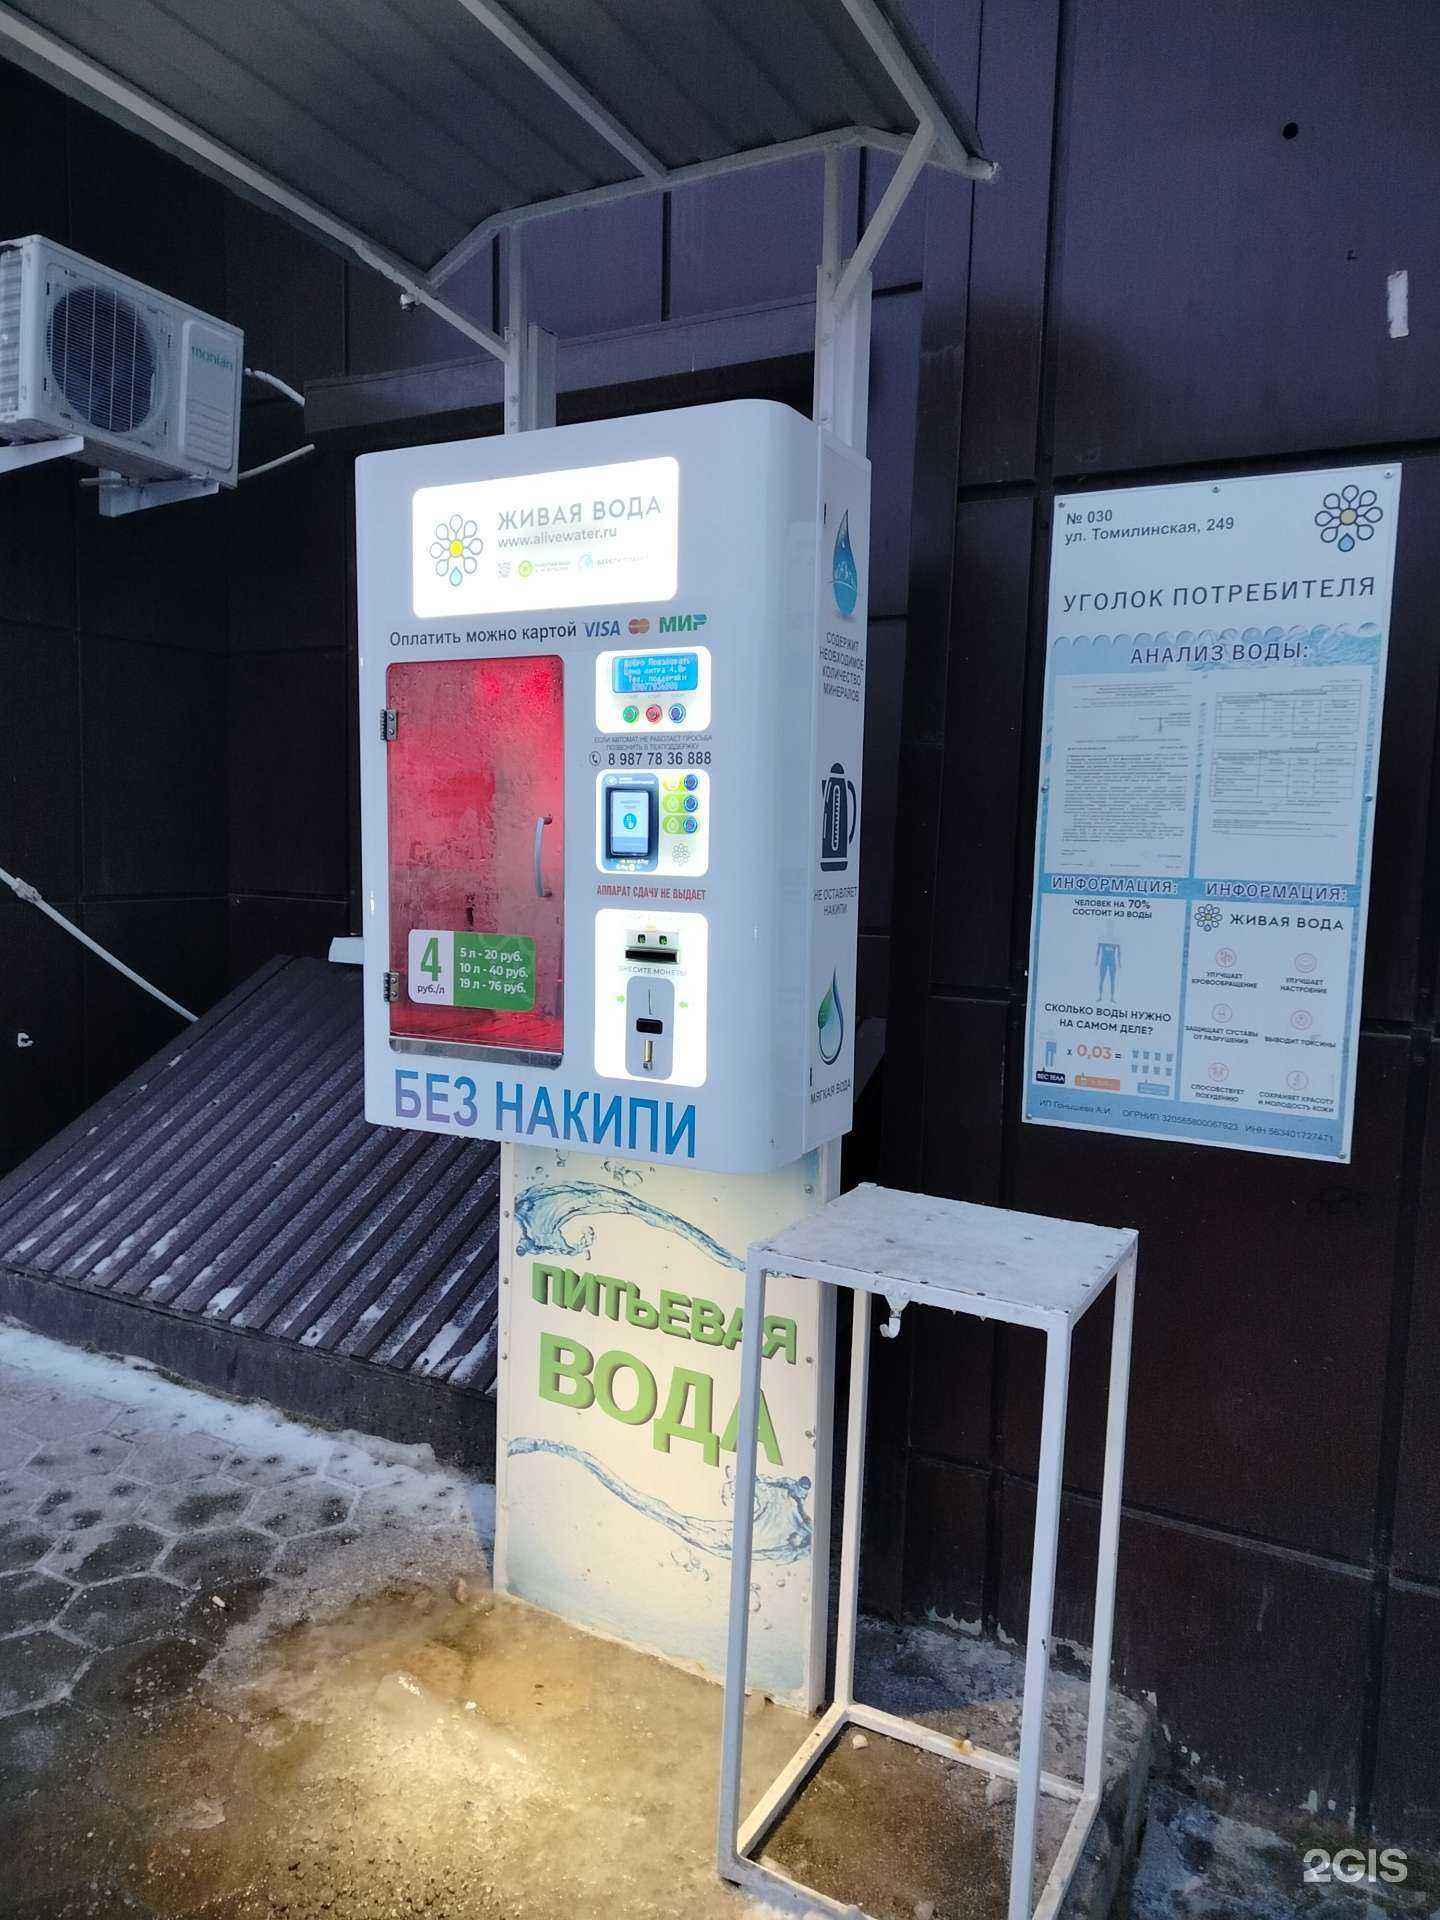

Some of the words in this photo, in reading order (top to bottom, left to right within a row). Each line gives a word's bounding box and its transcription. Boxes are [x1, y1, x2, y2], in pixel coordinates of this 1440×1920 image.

[498, 503, 582, 530] ЖИВАЯ
[593, 496, 661, 520] ВОДА
[1066, 513, 1082, 525] №
[1088, 510, 1113, 523] 030
[498, 527, 617, 548] www.alivewater.ru
[1065, 532, 1087, 546] ул.
[1093, 522, 1201, 540] Томилинская,
[1206, 517, 1234, 531] 249
[1063, 589, 1164, 612] УГОЛОК
[1173, 577, 1375, 606] ПОТРЕБИТЕЛЯ
[390, 631, 461, 647] Оплатить
[466, 629, 517, 643] можно
[522, 621, 577, 644] картой
[583, 620, 621, 637] VISA
[659, 614, 707, 633] МИР
[826, 632, 860, 652] СОДЕРЖИТ
[819, 648, 864, 672] НЕОБХОДИМОЕ
[1130, 644, 1223, 664] АНАЛИЗ
[1233, 642, 1308, 661] ВОДЫ:
[823, 665, 862, 687] КОЛИЧЕСТВО
[823, 683, 860, 702] МИНЕРАЛОВ
[608, 753, 615, 765] 8
[620, 752, 642, 765] 987
[647, 752, 662, 765] 78
[667, 752, 683, 765] 36
[687, 751, 712, 765] 888
[597, 884, 631, 897] АППАРАТ
[633, 886, 658, 899] СДАЧУ
[661, 887, 671, 899] НЕ
[673, 888, 706, 901] ВЫДАЕТ
[1052, 877, 1178, 894] ИНФОРМАЦИЯ:
[1206, 883, 1346, 901] ИНФОРМАЦИЯ:
[1072, 908, 1111, 917] СОСТОИТ
[1114, 909, 1125, 917] ИЗ
[1127, 910, 1152, 919] ВОДЫ
[1074, 900, 1111, 908] ЧЕЛОВЕК
[1128, 900, 1151, 909] 70%
[1230, 913, 1290, 928] ЖИВАЯ
[1297, 917, 1344, 931] ВОДА
[420, 937, 442, 981] 4
[460, 947, 467, 958] 5
[468, 950, 476, 958] л
[484, 950, 498, 960] 20
[501, 951, 523, 963] руб.
[460, 963, 471, 973] 10
[472, 965, 480, 974] л
[489, 965, 504, 976] 40
[506, 966, 529, 979] руб.
[417, 983, 445, 995] руб./л
[460, 978, 471, 989] 19
[472, 980, 480, 989] л
[489, 981, 501, 992] 76
[504, 982, 527, 995] руб.
[1044, 1003, 1093, 1016] СКОЛЬКО
[1096, 1007, 1128, 1019] ВОДЫ
[1131, 1011, 1172, 1022] НУЖНО
[1059, 1018, 1074, 1028] НА
[1076, 1020, 1117, 1032] САМОМ
[1120, 1024, 1154, 1036] ДЕЛЕ?
[1076, 1044, 1112, 1060] 0,03
[395, 1068, 479, 1128] БЕЗ
[495, 1081, 697, 1158] НАКИПИ
[539, 1331, 784, 1467] ВОДА
